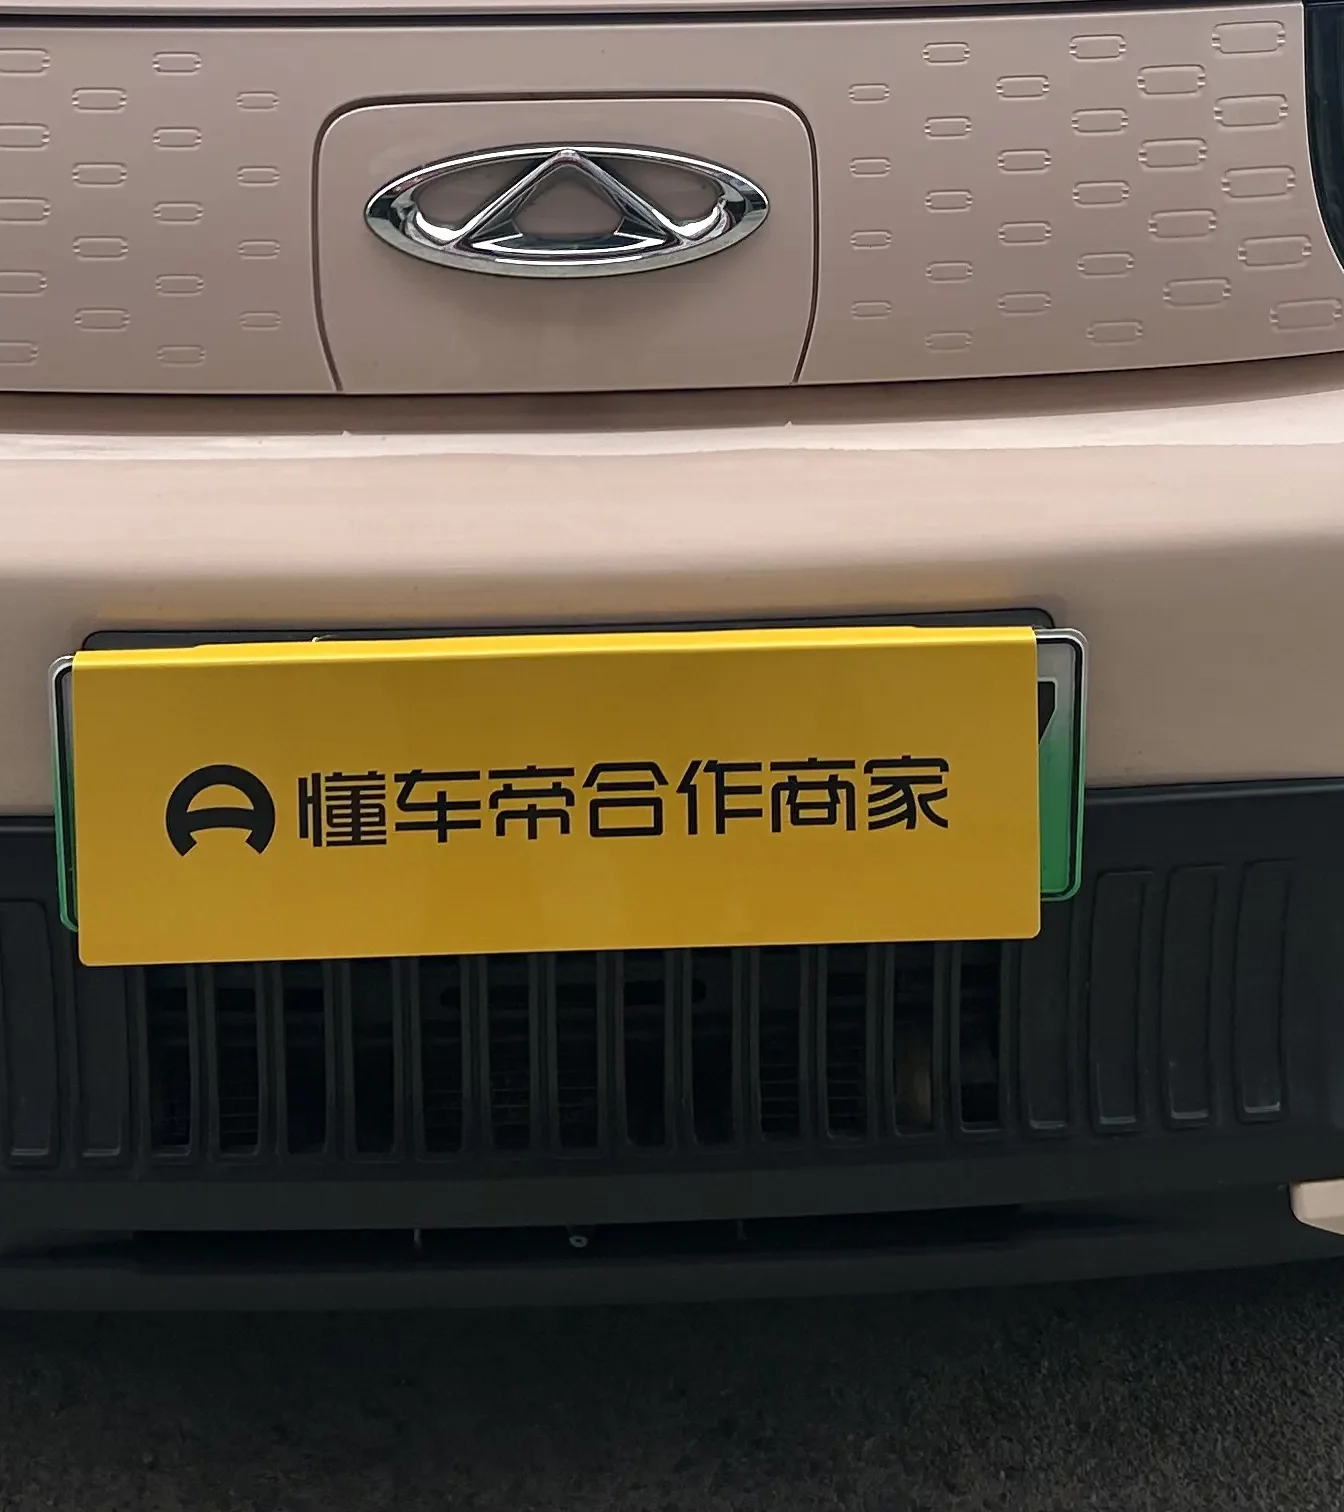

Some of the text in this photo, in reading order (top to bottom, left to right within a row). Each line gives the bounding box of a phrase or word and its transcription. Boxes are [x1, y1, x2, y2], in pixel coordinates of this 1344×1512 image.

[298, 755, 949, 847] 懂车帝合作商家
